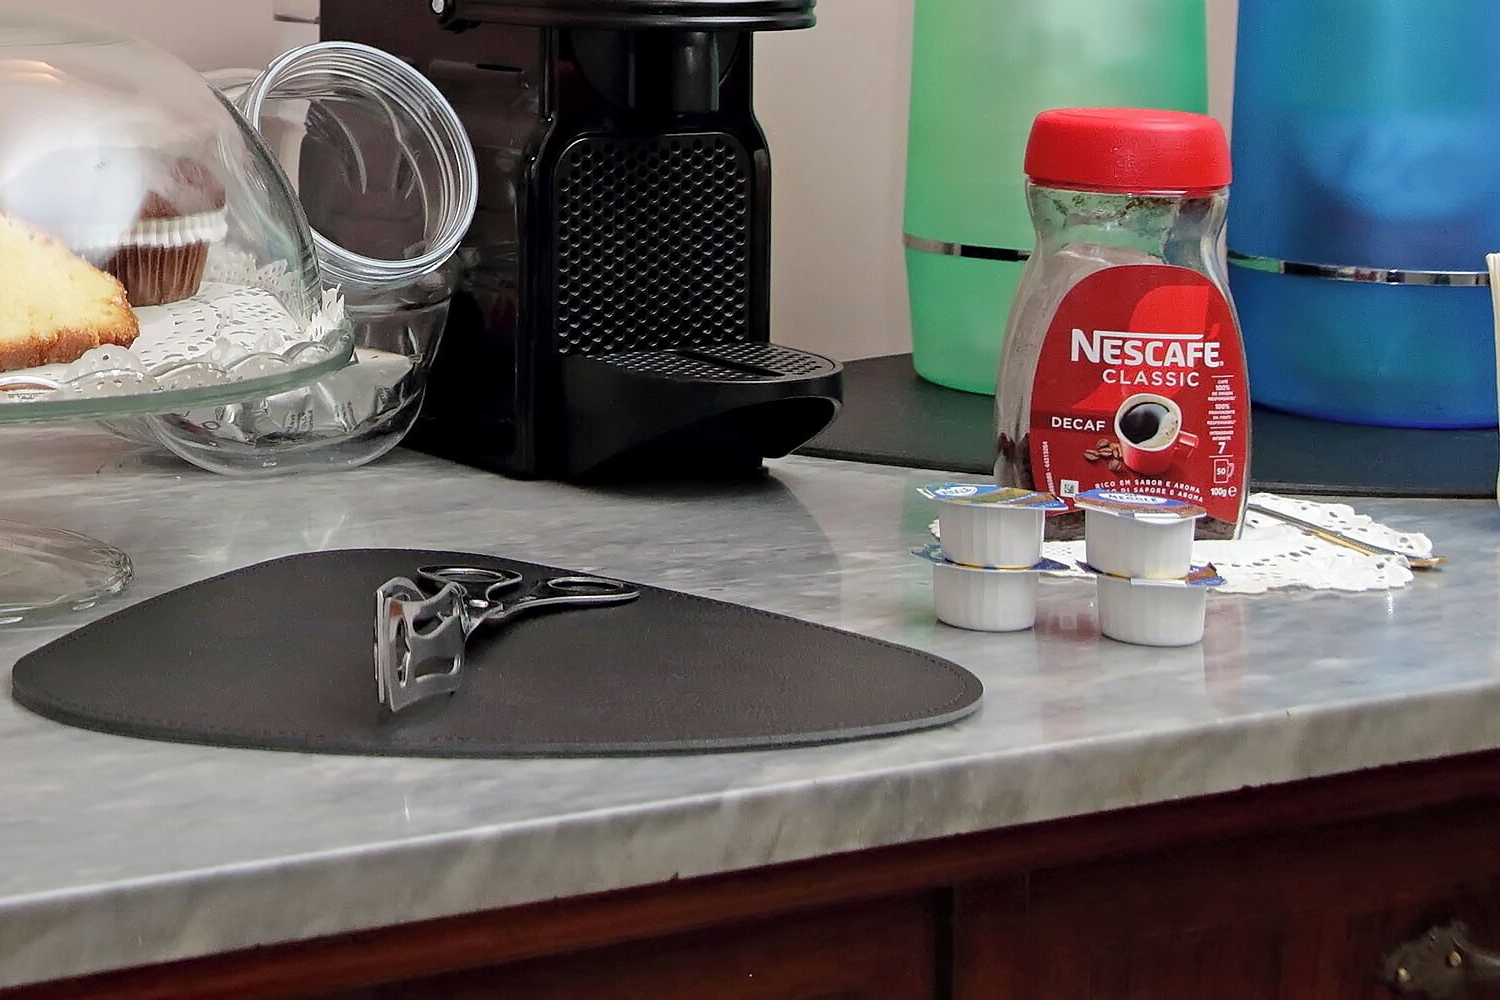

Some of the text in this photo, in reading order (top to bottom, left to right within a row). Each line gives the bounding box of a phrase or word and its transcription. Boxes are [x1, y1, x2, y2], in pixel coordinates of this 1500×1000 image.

[1102, 368, 1200, 387] CLASSIC
[1051, 416, 1106, 432] DECAF
[1218, 442, 1226, 454] 7
[1133, 487, 1166, 495] SAPORE
[1177, 492, 1203, 503] AROMA
[1174, 483, 1200, 493] AROMA
[1210, 488, 1228, 497] 100g
